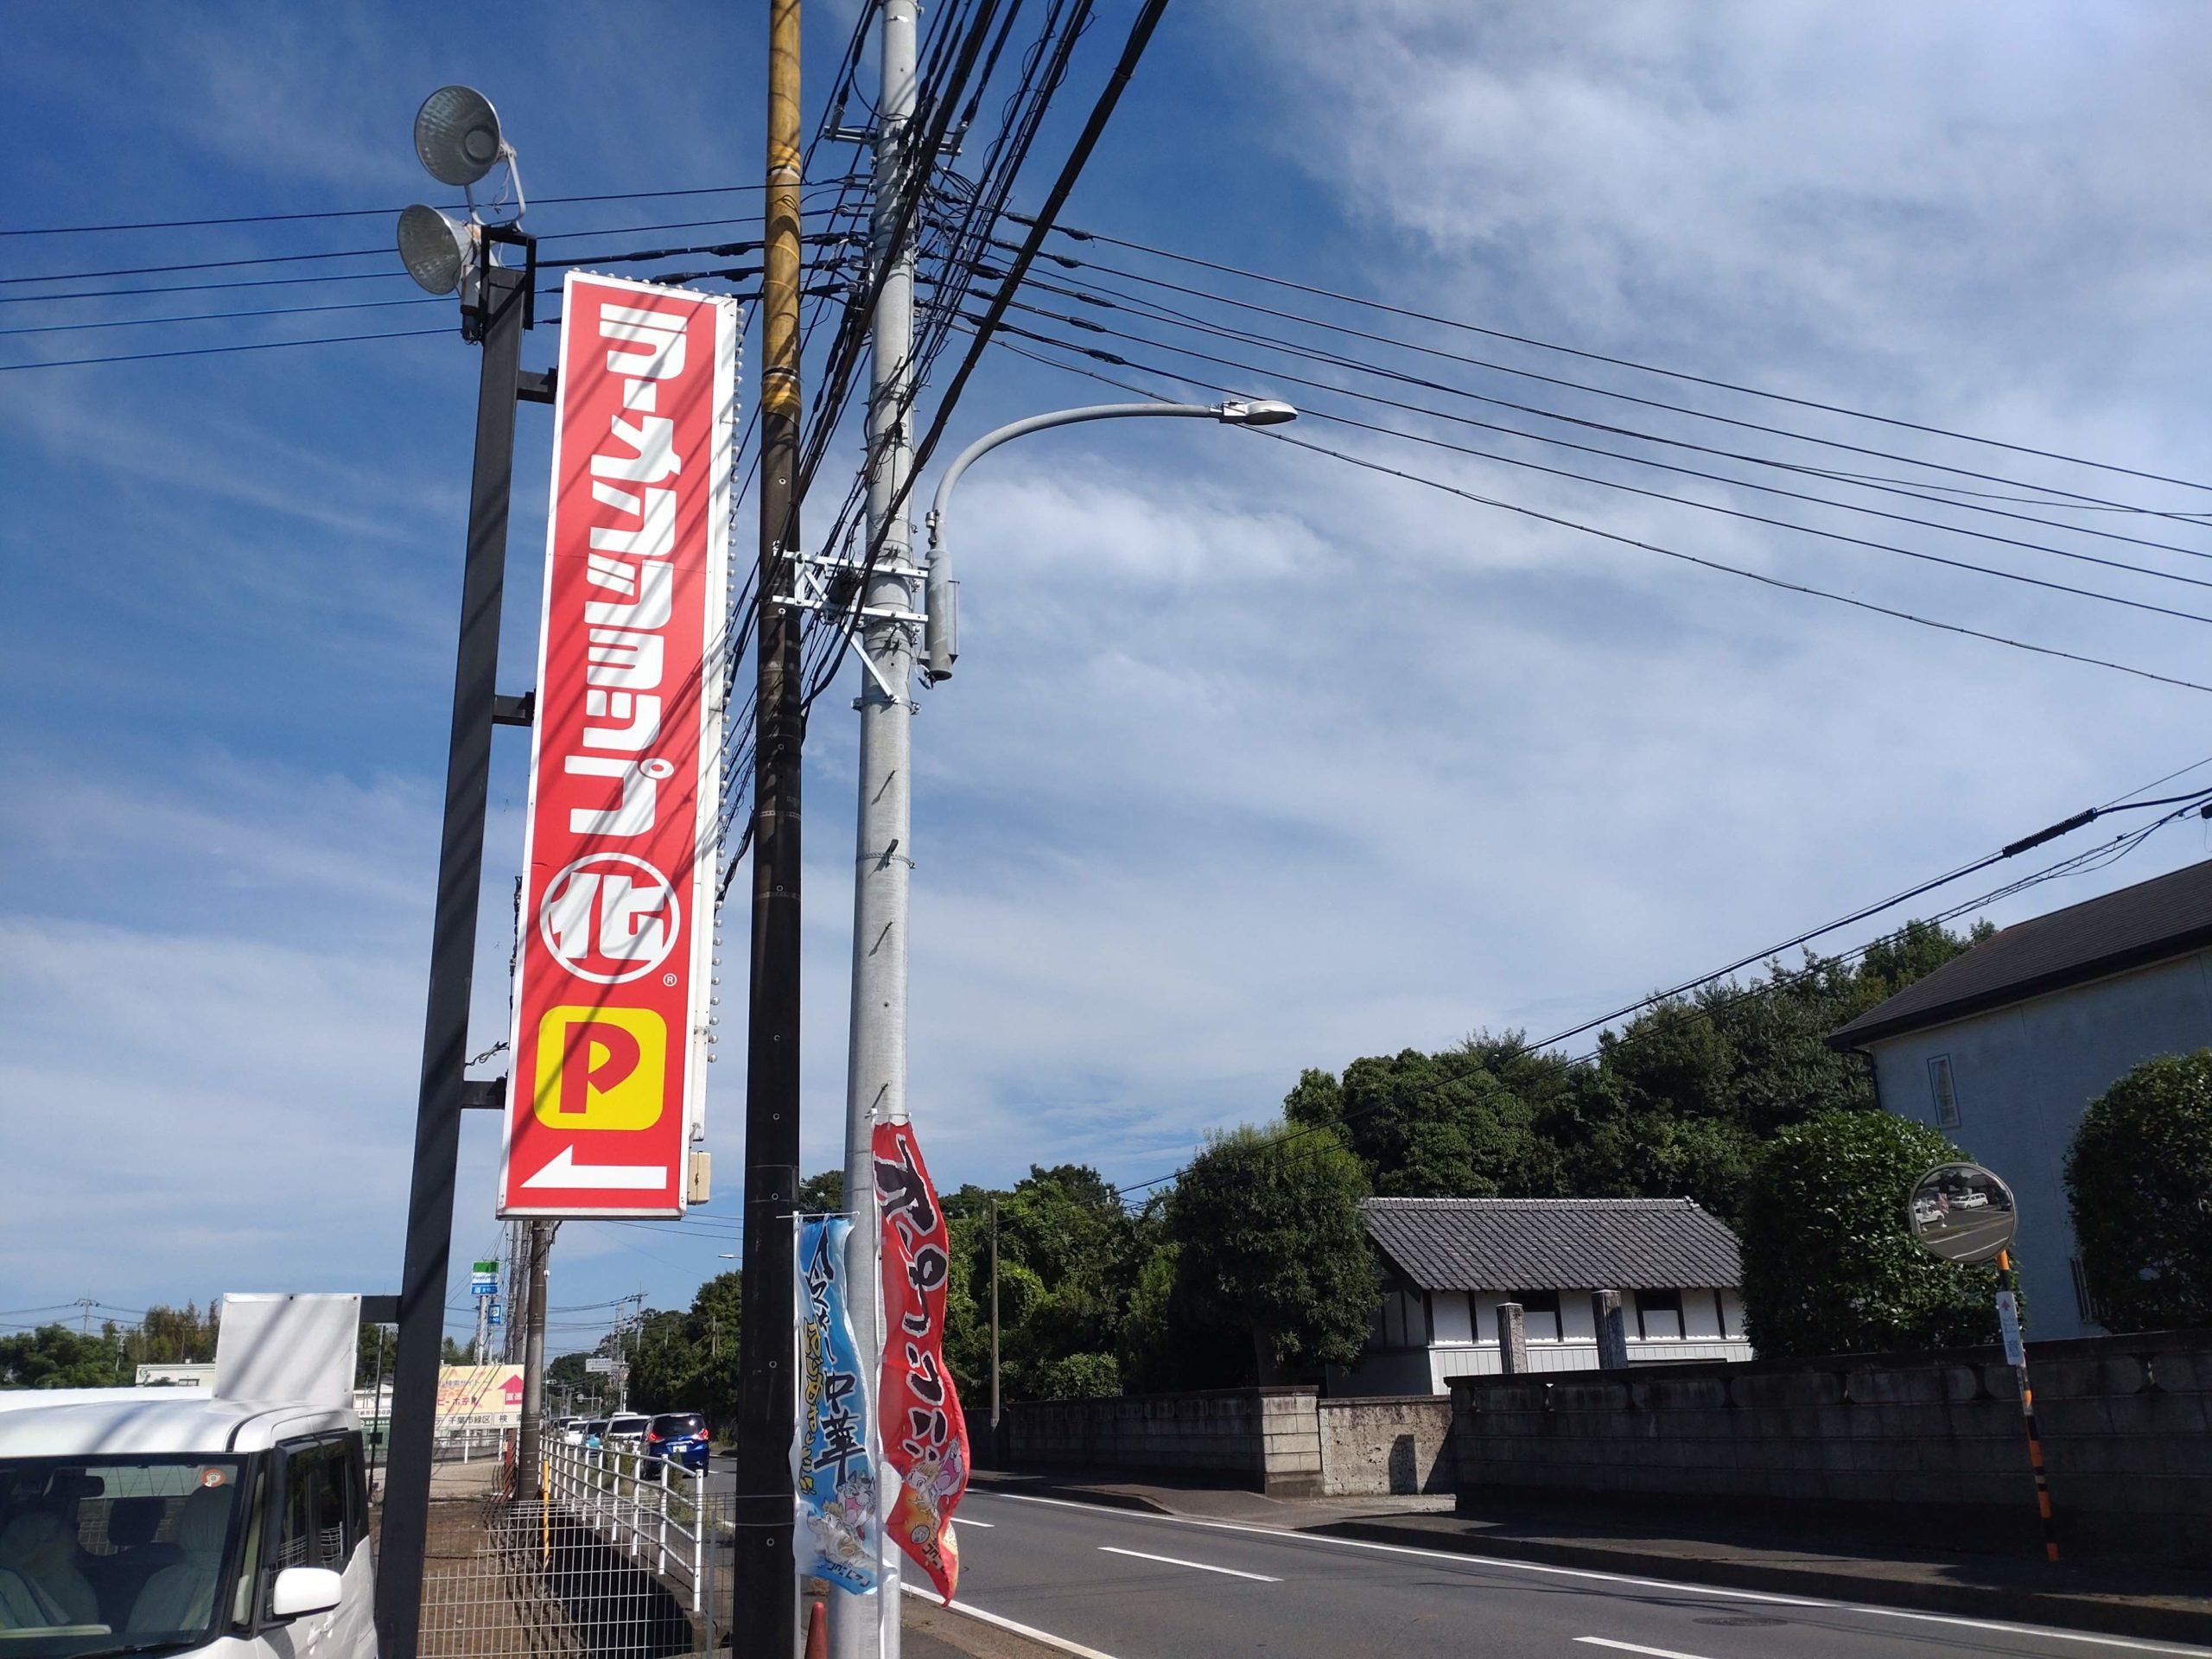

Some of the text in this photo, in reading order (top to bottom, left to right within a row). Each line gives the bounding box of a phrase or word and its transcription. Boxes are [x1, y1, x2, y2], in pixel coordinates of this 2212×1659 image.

[564, 302, 689, 836] ラーメンショップ
[559, 1021, 640, 1114] P
[448, 1415, 491, 1426] 千葉市緑区
